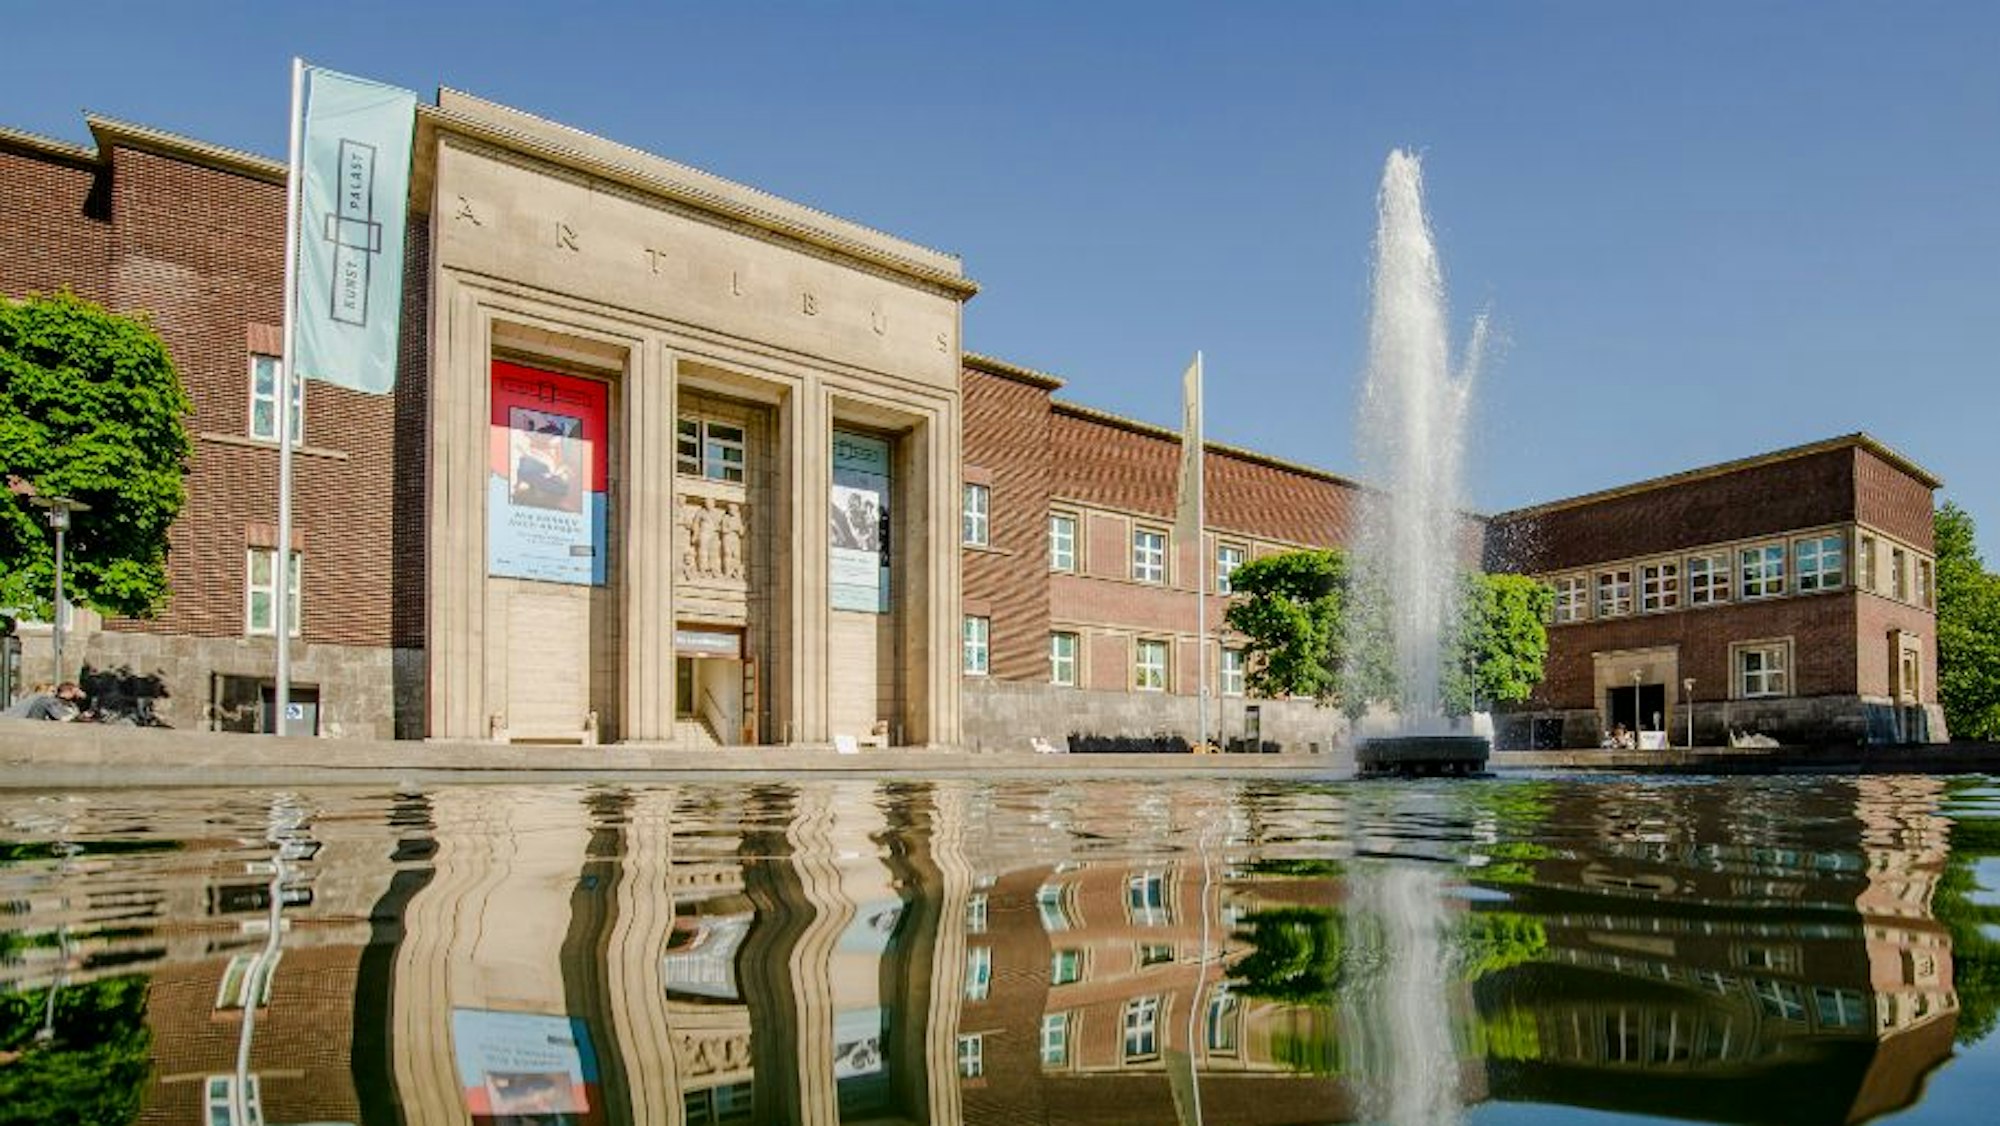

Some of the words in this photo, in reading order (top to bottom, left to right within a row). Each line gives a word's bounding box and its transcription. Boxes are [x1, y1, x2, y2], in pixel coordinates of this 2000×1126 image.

[350, 152, 364, 210] PALAST
[344, 260, 358, 309] KUNST
[455, 193, 949, 354] ARTIBUS
